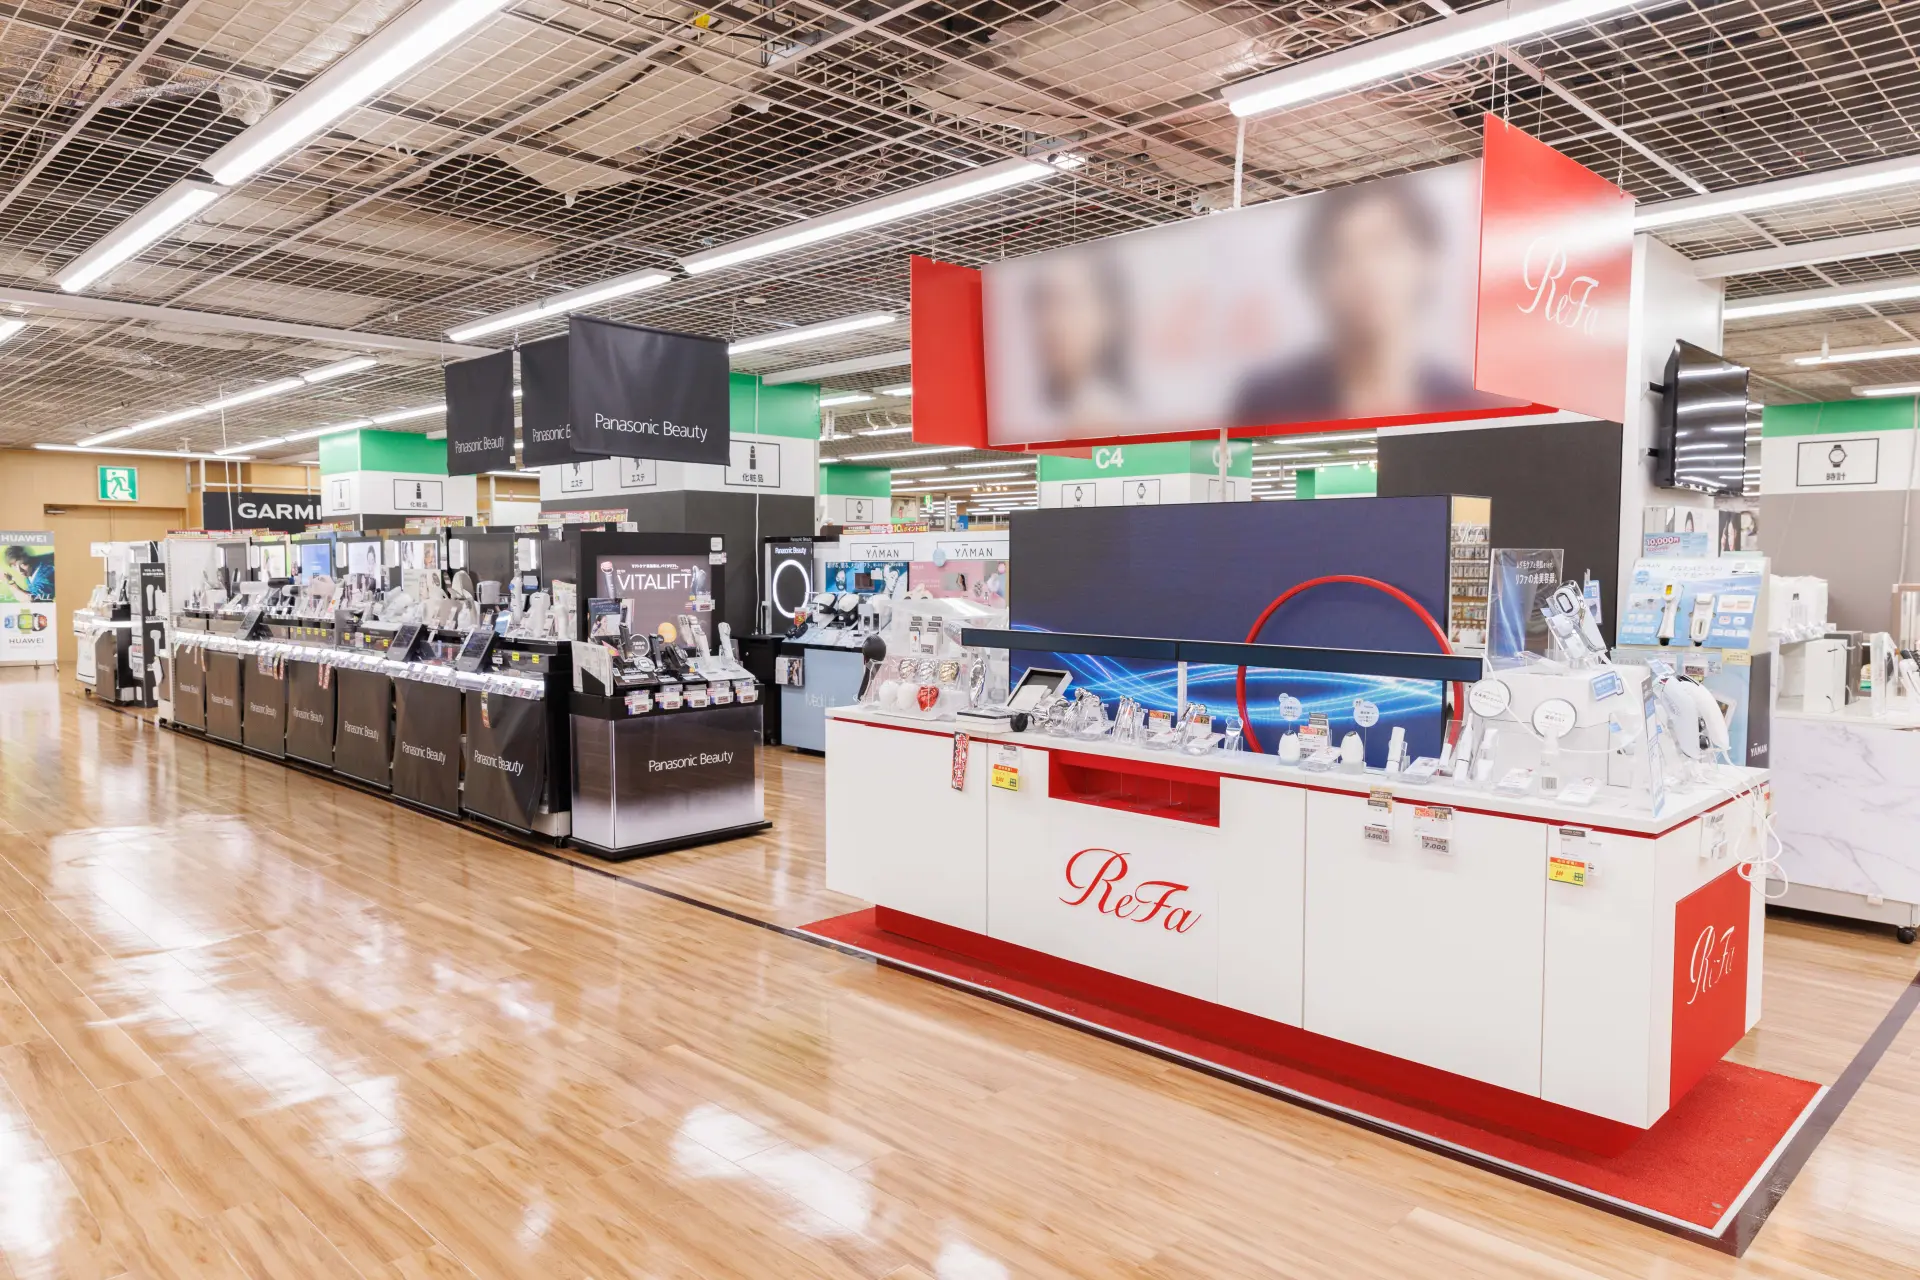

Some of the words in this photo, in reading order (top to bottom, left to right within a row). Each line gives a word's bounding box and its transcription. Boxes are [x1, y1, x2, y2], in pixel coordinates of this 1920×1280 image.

[1517, 236, 1600, 336] ReFa
[532, 424, 565, 442] Panasonic
[595, 412, 660, 435] Panasonic
[663, 420, 708, 442] Beauty
[454, 437, 483, 454] Panasonic
[483, 435, 505, 451] Beauty
[1095, 447, 1124, 469] C4
[570, 479, 583, 488] エステ
[631, 473, 645, 483] エステ
[742, 473, 764, 483] 化粧品
[237, 502, 323, 520] GARMI
[1, 534, 47, 544] HUAWEI
[774, 546, 793, 555] Panasonic
[793, 546, 807, 556] Beauty
[617, 573, 692, 590] VITALIFT
[250, 702, 266, 714] Panasonic
[266, 705, 277, 719] Beauty
[292, 707, 310, 720] Panasonic
[310, 710, 324, 726] Beauty
[344, 720, 363, 736] Panasonic
[364, 725, 379, 742] Beauty
[402, 741, 425, 759] Panasonic
[426, 747, 447, 765] Beauty
[648, 754, 698, 772] Panasonic
[700, 751, 734, 765] Beauty
[474, 750, 498, 769] Panasonic
[498, 755, 524, 776] Beauty
[1059, 848, 1202, 933] ReFa
[1686, 925, 1735, 1005] ReFa
